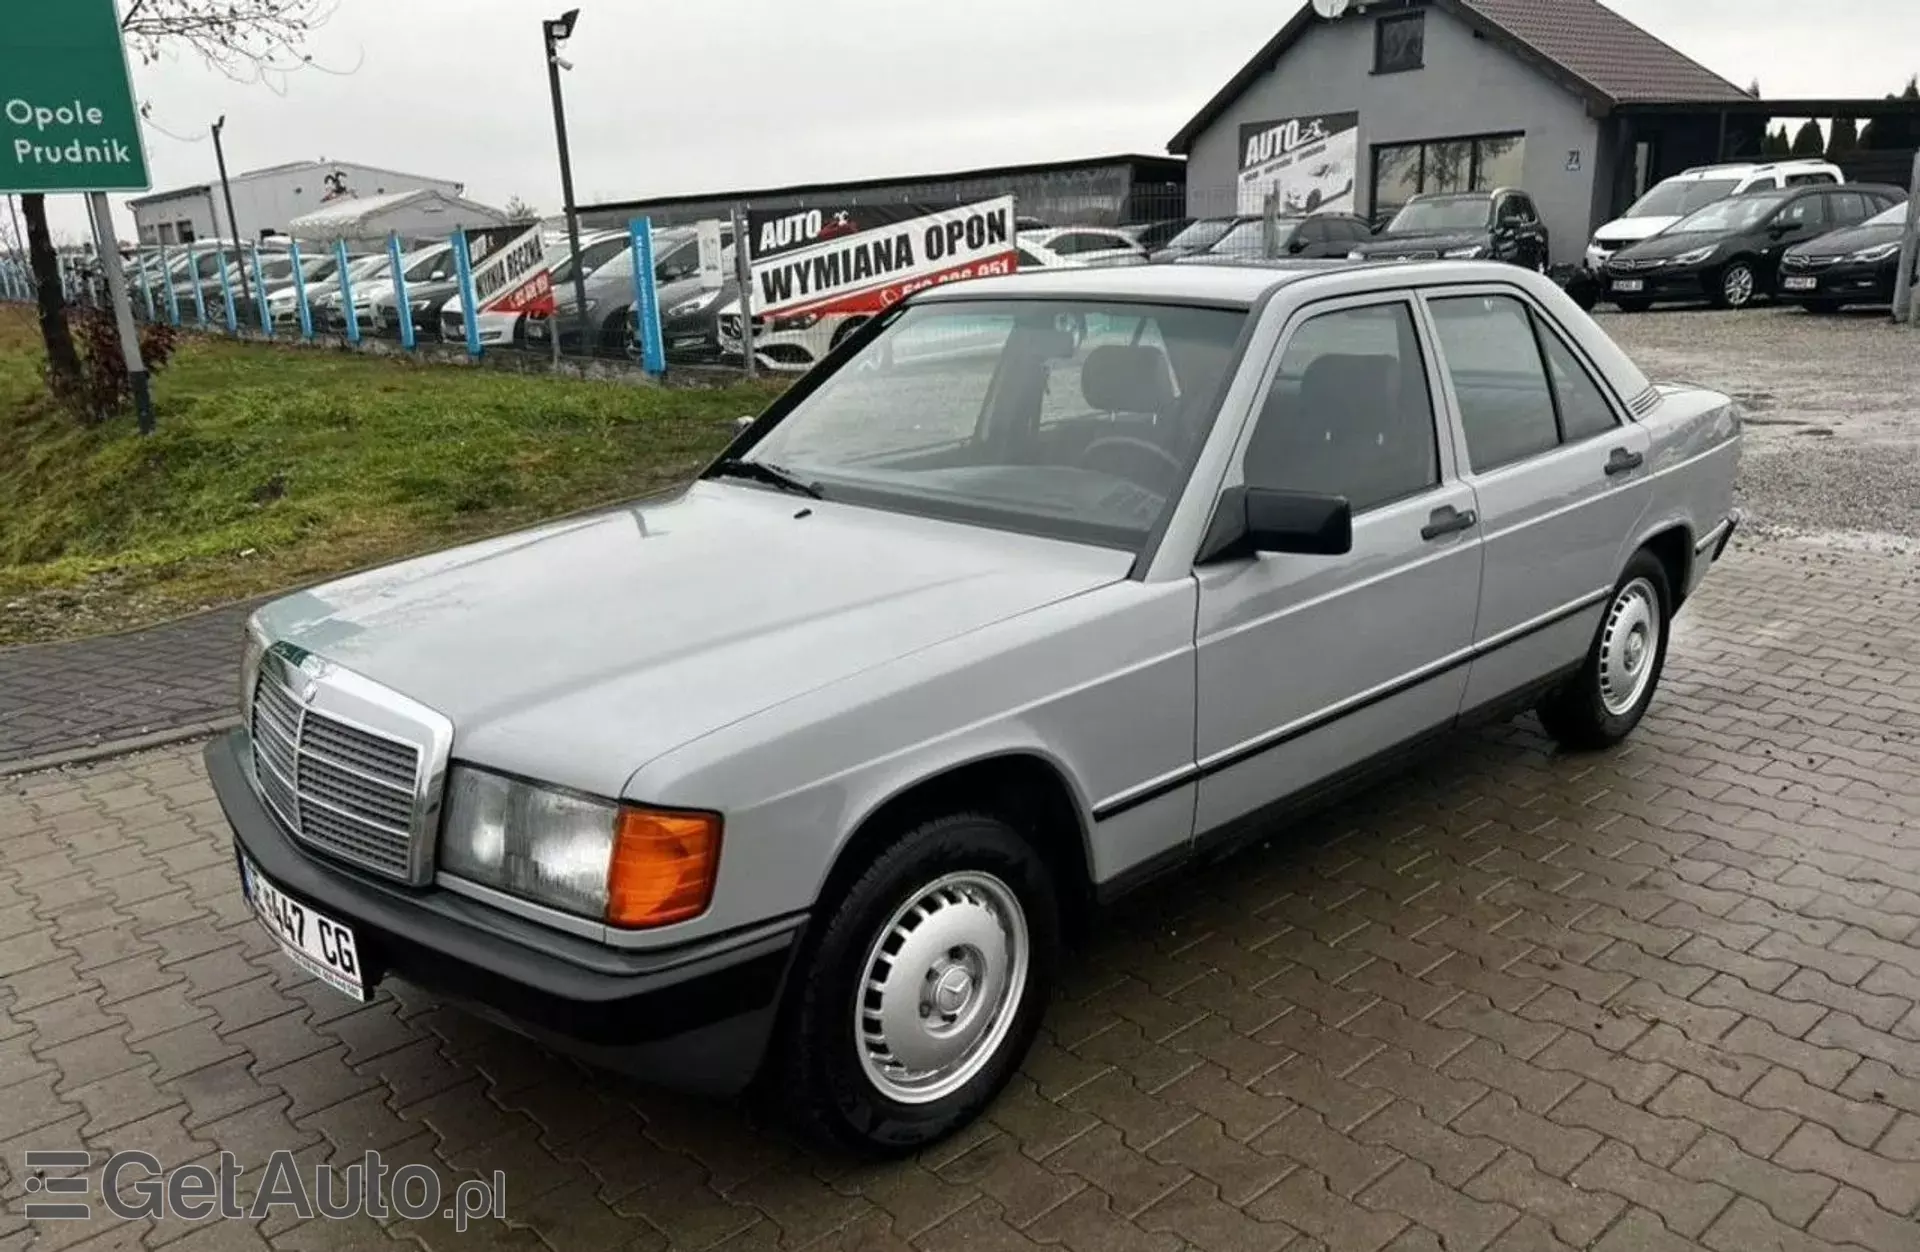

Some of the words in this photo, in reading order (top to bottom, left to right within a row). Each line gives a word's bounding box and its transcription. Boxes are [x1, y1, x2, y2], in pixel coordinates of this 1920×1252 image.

[5, 98, 104, 132] Opole
[14, 138, 131, 163] Prudnik
[1245, 119, 1300, 167] AUTO
[760, 209, 822, 252] AUTO
[761, 233, 915, 305] WYMIANA
[925, 208, 1007, 261] OPON
[318, 918, 356, 976] CG
